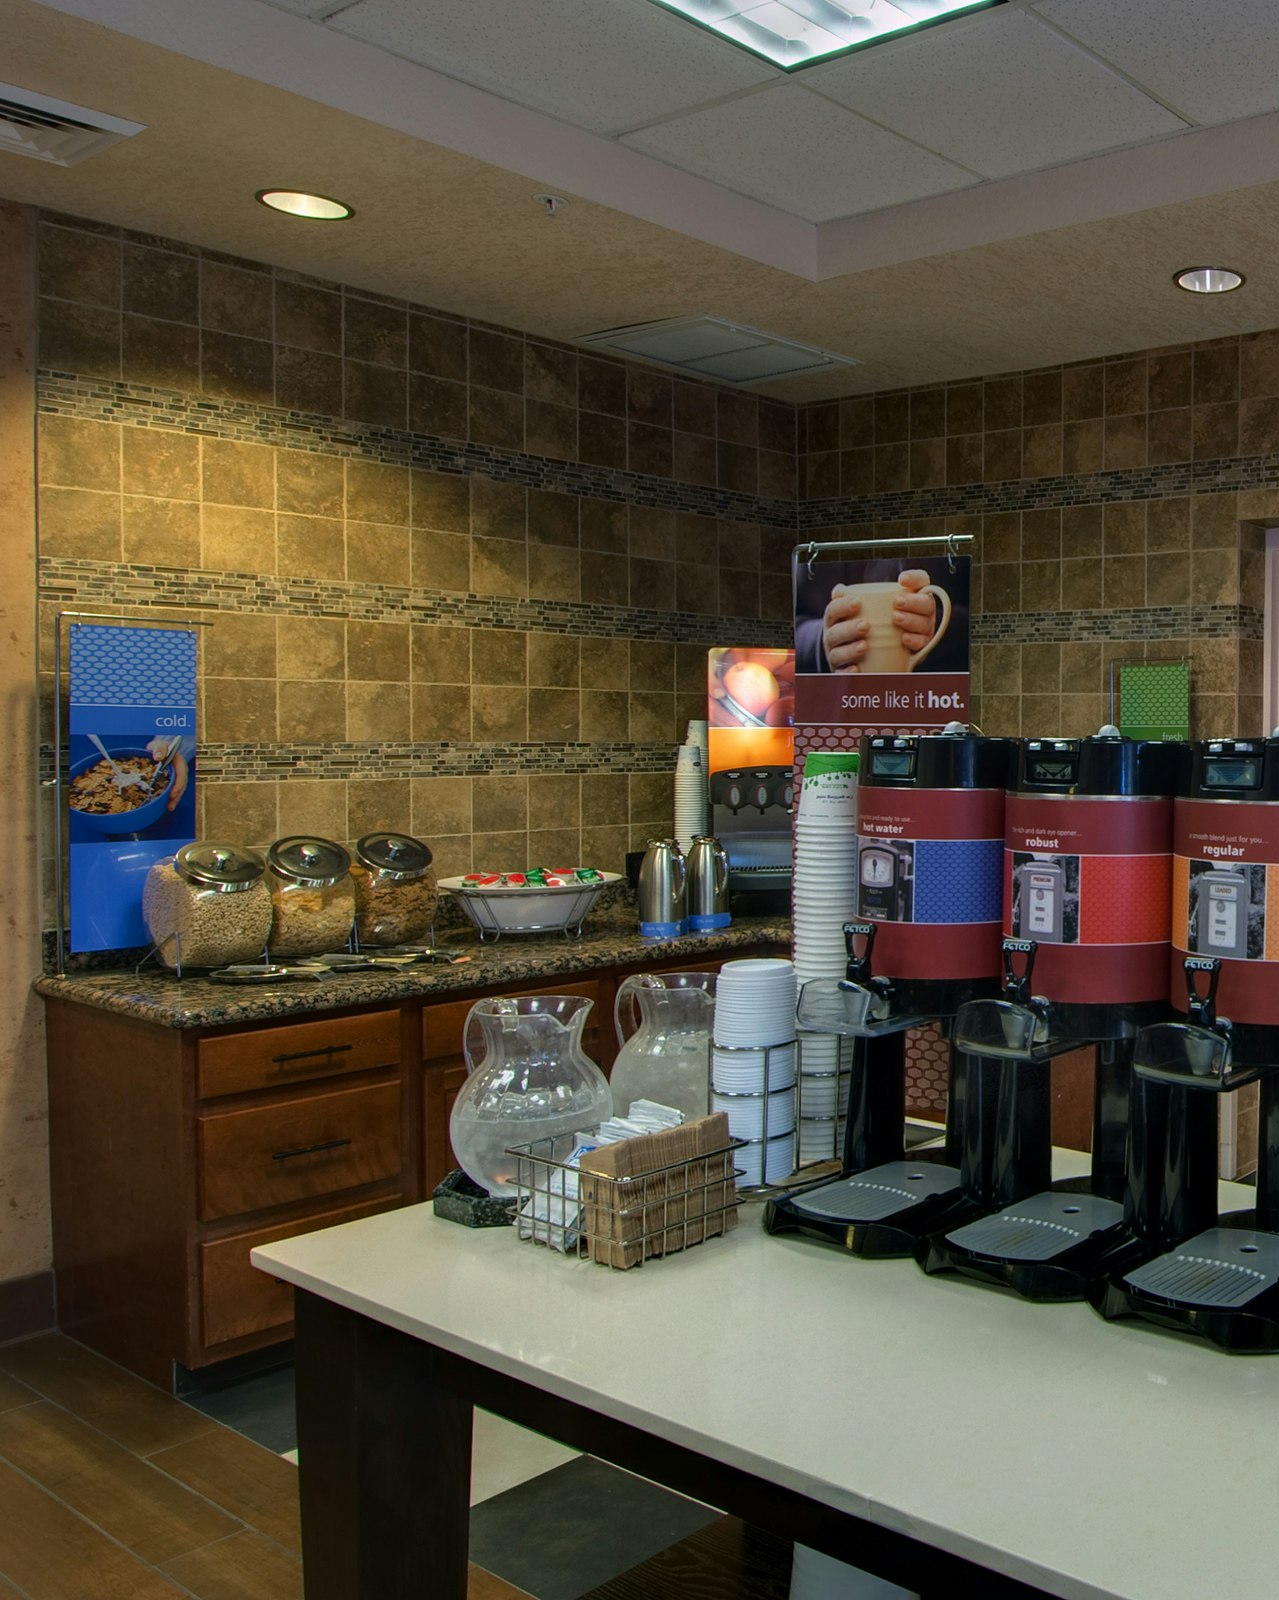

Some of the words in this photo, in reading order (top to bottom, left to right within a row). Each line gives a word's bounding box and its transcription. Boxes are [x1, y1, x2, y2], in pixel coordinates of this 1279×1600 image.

[841, 695, 880, 709] some
[885, 690, 910, 709] like
[914, 690, 924, 709] it
[927, 690, 965, 709] hot.
[155, 714, 191, 727] cold.
[1161, 731, 1184, 742] fresh
[863, 821, 874, 832] hot
[875, 824, 904, 834] water
[1025, 836, 1059, 848] robust
[1202, 844, 1245, 857] regular
[844, 925, 870, 934] FETCO
[1002, 942, 1031, 951] FETCO
[1184, 959, 1214, 970] FETCO
